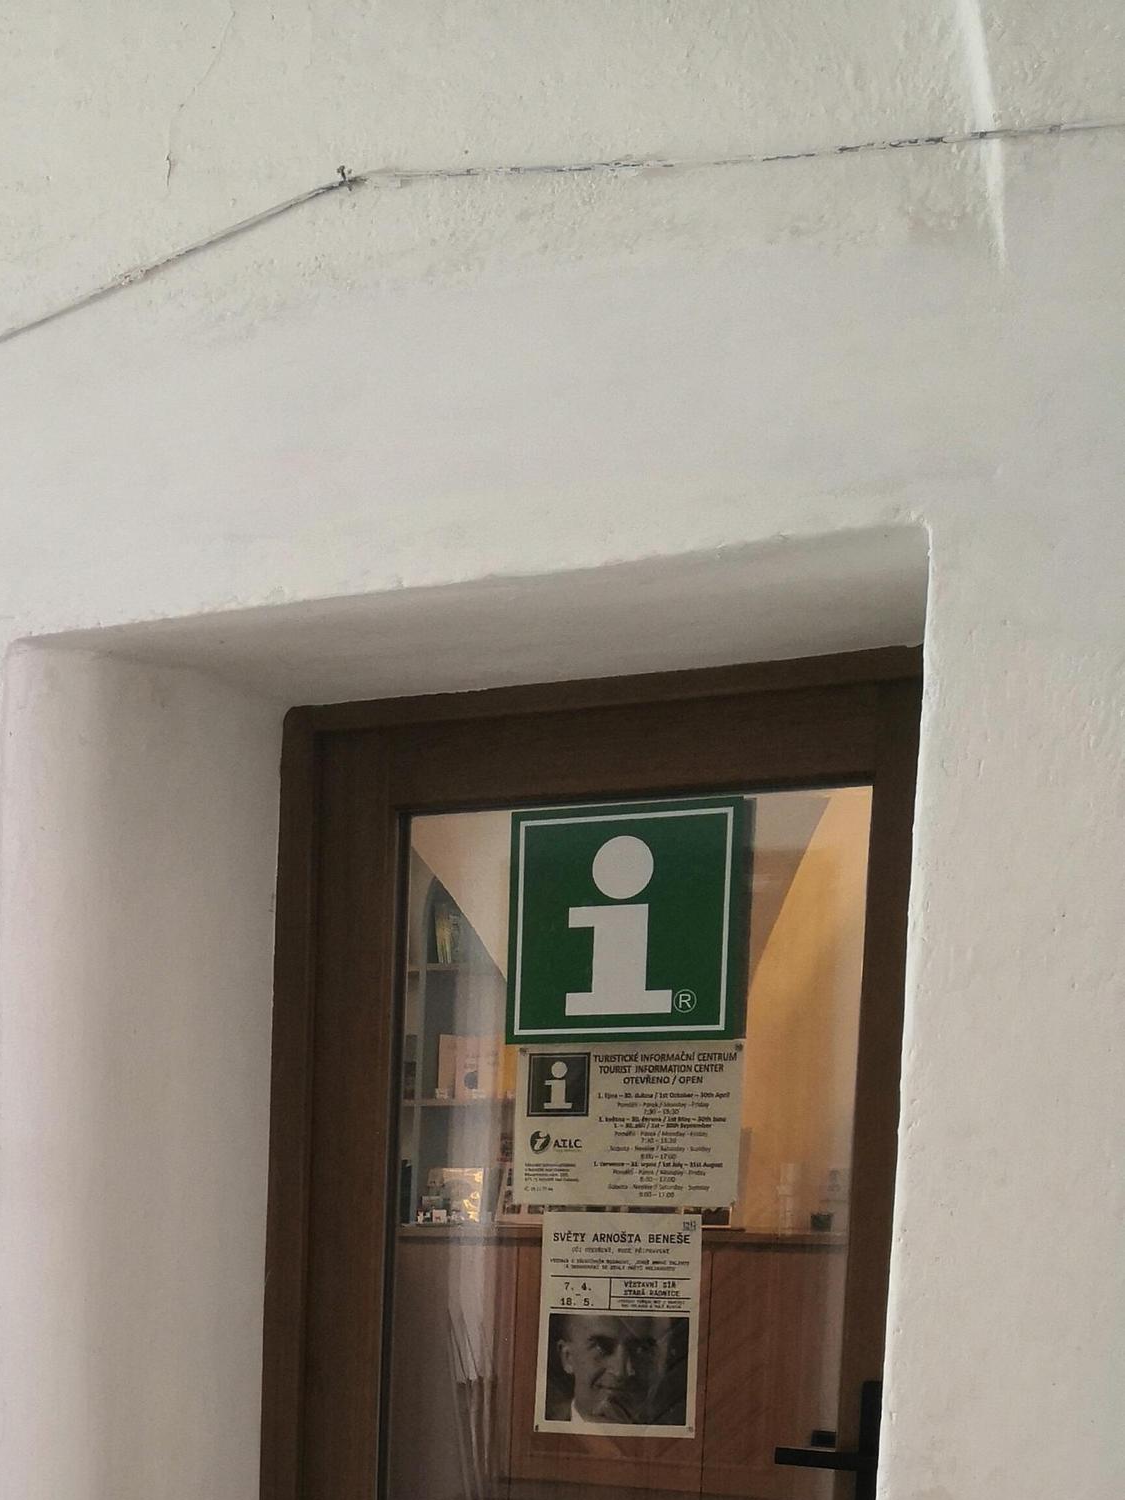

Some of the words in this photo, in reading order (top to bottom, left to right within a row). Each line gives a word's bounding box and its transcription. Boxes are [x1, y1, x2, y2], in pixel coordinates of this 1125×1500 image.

[593, 1052, 639, 1062] TURISTICKÉ
[641, 1051, 695, 1062] INFORMAČNÍ
[698, 1052, 737, 1061] CENTRUM
[599, 1065, 631, 1074] TOURIST
[635, 1064, 692, 1073] INFORMATION
[694, 1063, 724, 1072] CENTER
[623, 1074, 670, 1084] OTEVŘENO
[679, 1075, 703, 1084] OPEN
[553, 1231, 586, 1243] SVĚTY
[592, 1231, 641, 1243] ARNOŠTA
[649, 1232, 691, 1244] BENEŠE
